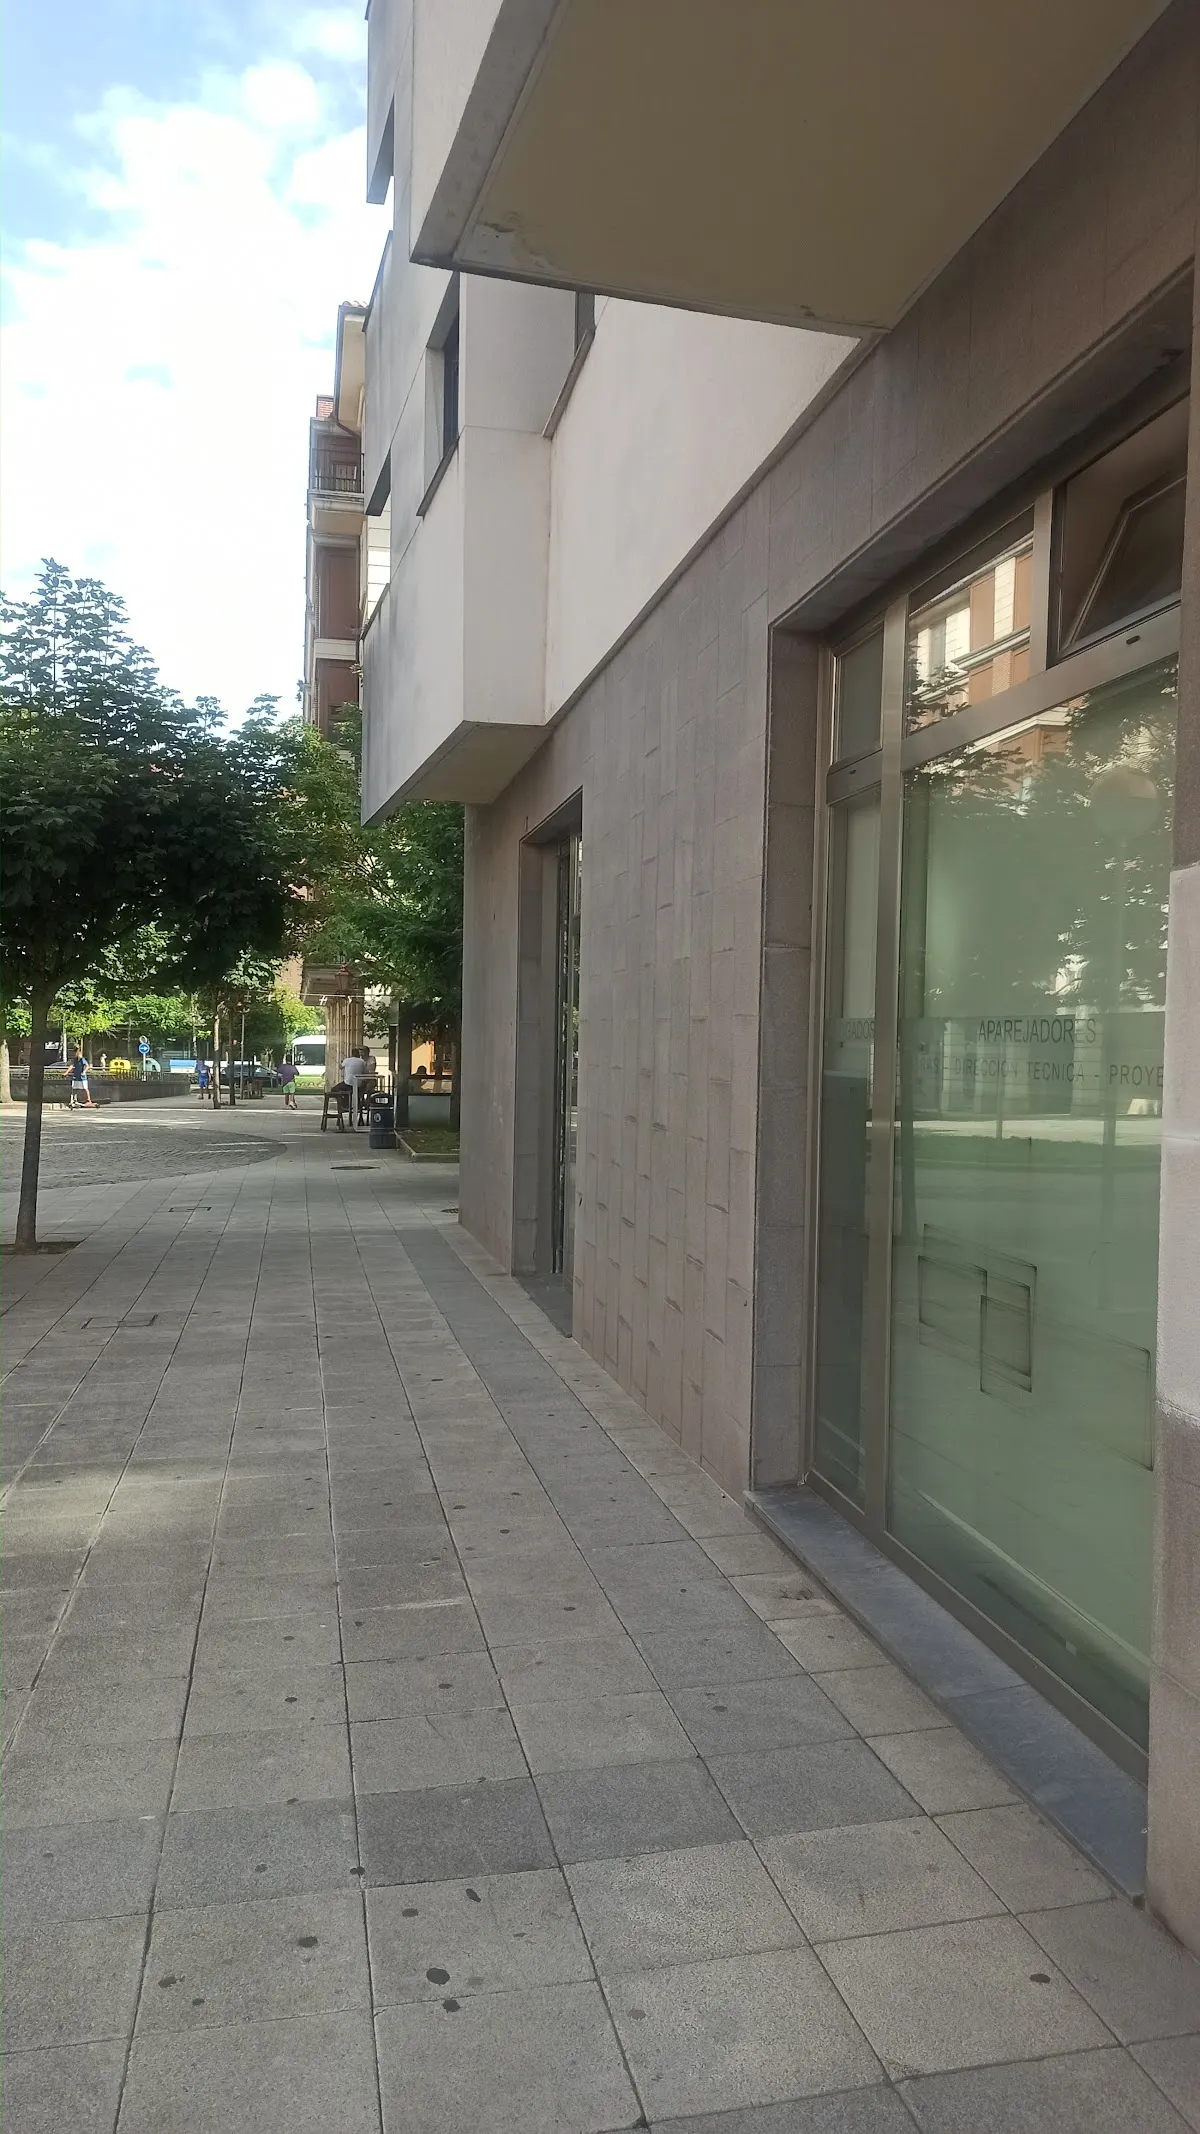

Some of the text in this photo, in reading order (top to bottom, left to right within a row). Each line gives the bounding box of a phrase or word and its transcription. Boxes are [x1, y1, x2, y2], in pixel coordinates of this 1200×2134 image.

[978, 1018, 1096, 1043] APAREJADORES
[955, 1057, 1018, 1078] DIRECCION
[1026, 1061, 1085, 1083] TECNICA
